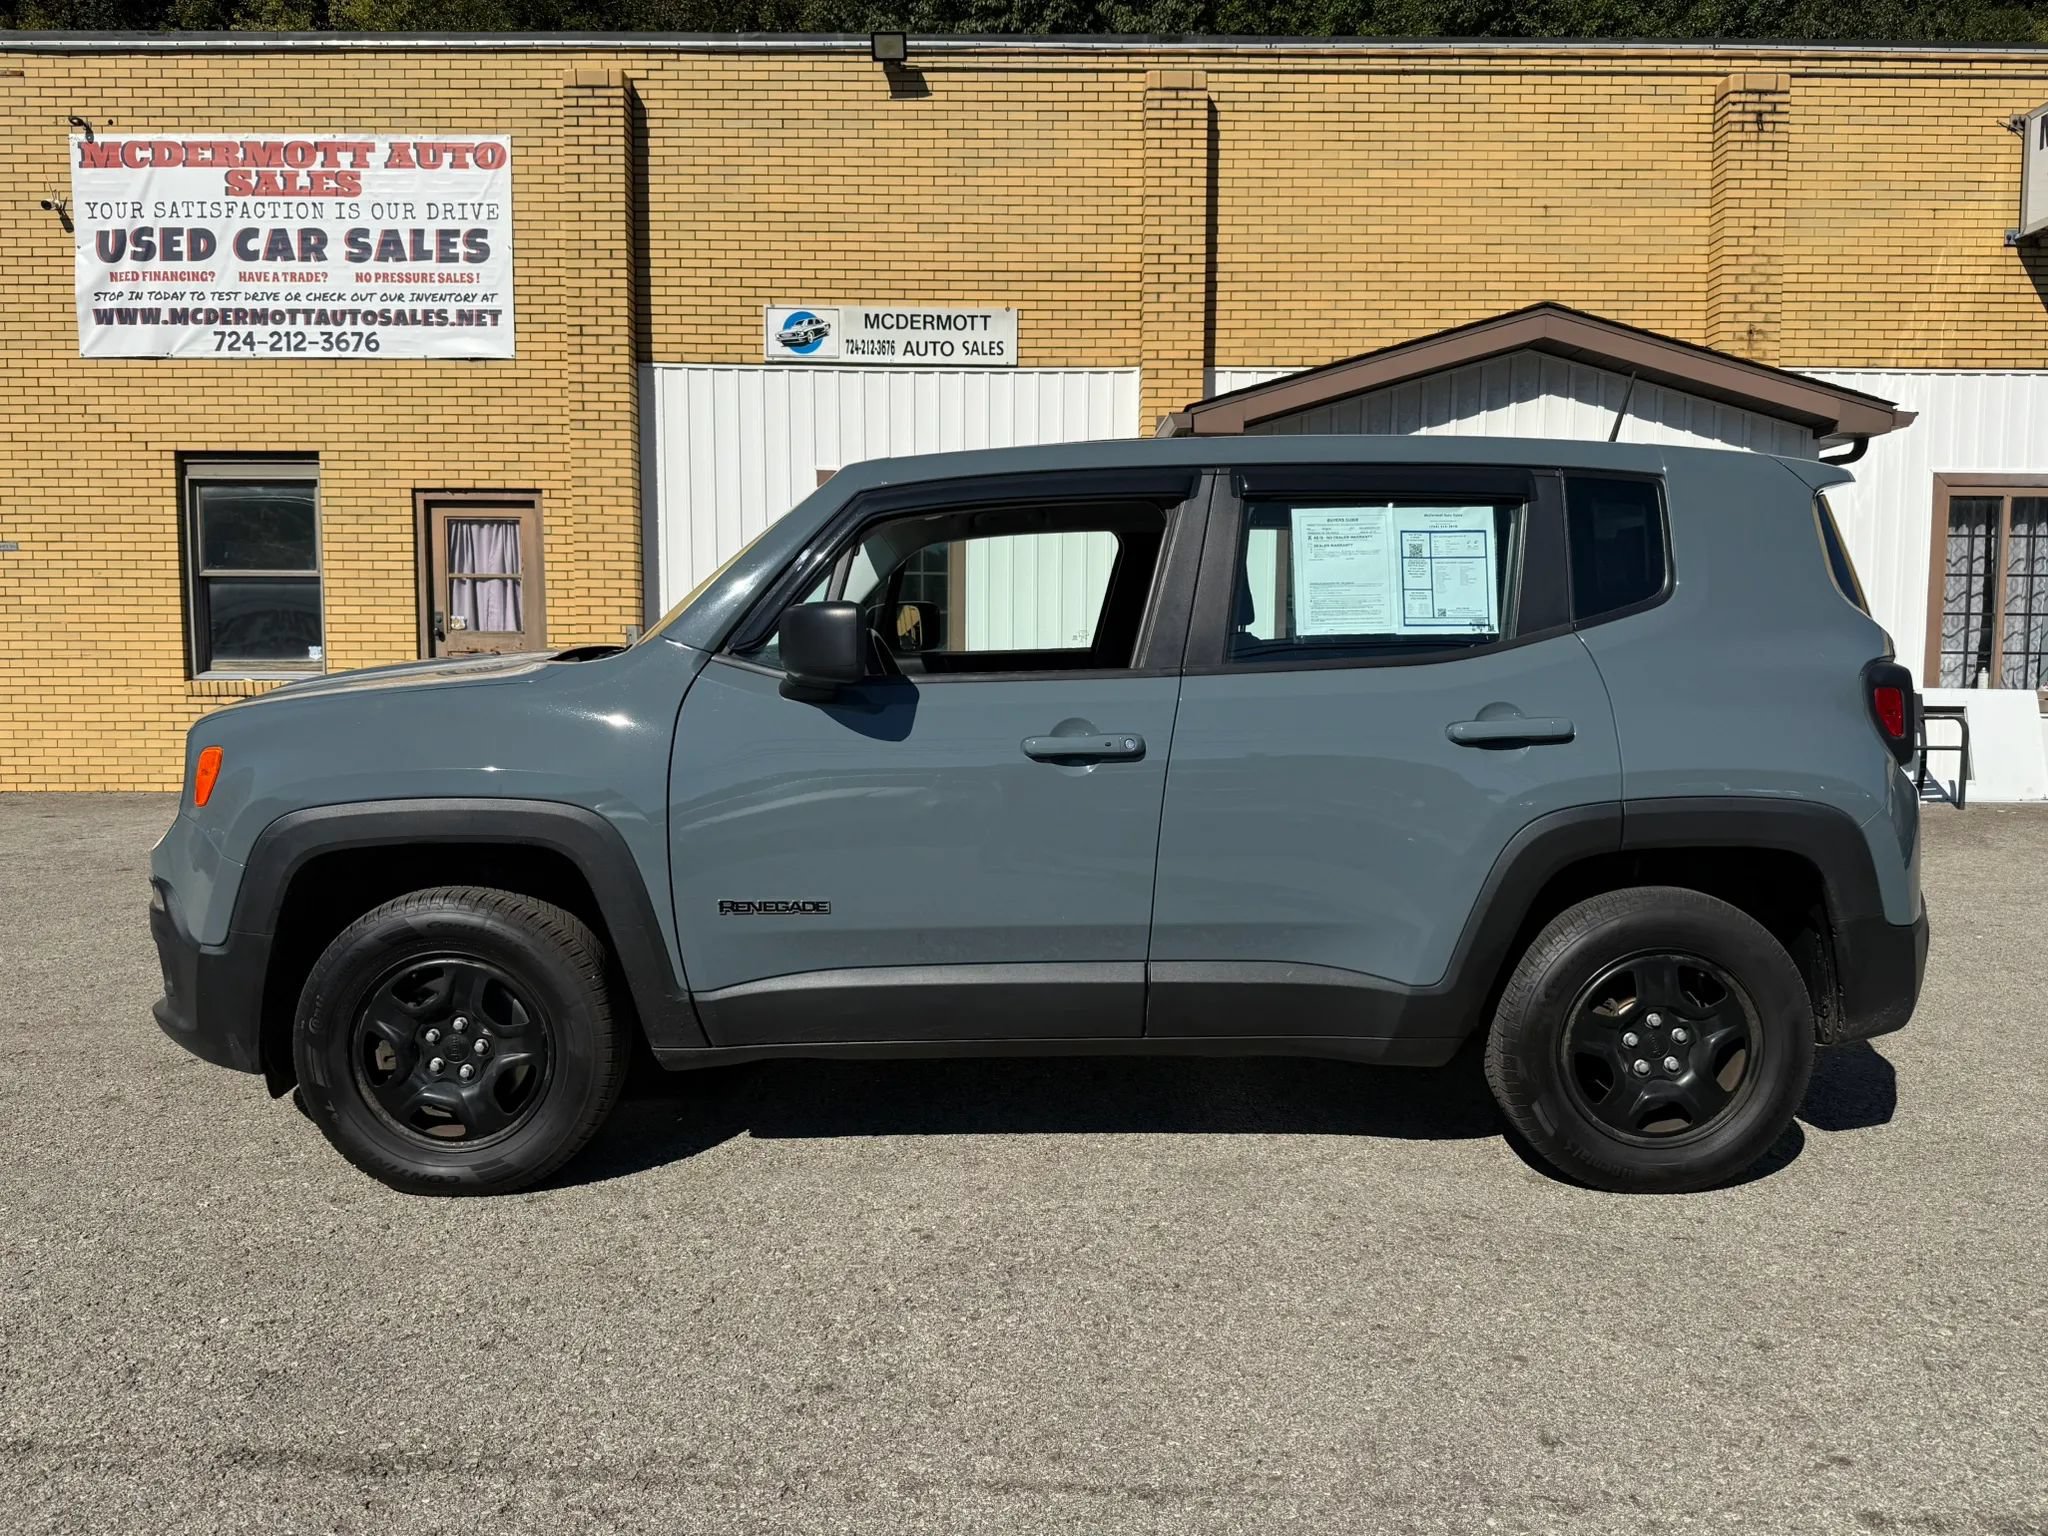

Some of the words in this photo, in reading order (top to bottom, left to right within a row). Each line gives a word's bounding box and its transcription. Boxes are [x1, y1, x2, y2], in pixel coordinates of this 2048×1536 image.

[78, 141, 375, 168] MCDERMOTT
[384, 142, 506, 169] AUTO
[225, 170, 362, 197] SALES
[86, 201, 144, 219] YOUR
[154, 201, 324, 219] SATISFACTION
[335, 202, 360, 219] IS
[371, 202, 416, 220] OUR
[427, 202, 499, 220] DRIVE
[95, 226, 217, 263] USED
[233, 227, 328, 263] CAR
[344, 227, 490, 263] SALES
[110, 271, 139, 283] NEED
[142, 271, 216, 283] FINANCING?
[239, 271, 271, 282] HAVE
[272, 272, 280, 282] A
[281, 272, 328, 283] TRADE?
[355, 272, 371, 283] NO
[375, 272, 435, 283] PRESSURE
[94, 291, 123, 301] STOP
[128, 291, 143, 301] IN
[148, 291, 186, 301] TODAY
[190, 291, 206, 301] TO
[210, 291, 241, 301] TEST
[245, 292, 280, 301] DRIVE
[285, 292, 301, 301] OR
[306, 292, 346, 302] CHECK
[351, 292, 376, 302] OUT
[380, 292, 405, 302] OUR
[409, 292, 477, 302] INVENTORY
[481, 293, 498, 302] AT
[93, 307, 502, 326] WWW.MCDERMOTTAUTOSALES.NET
[864, 313, 991, 331] MCDERMOTT
[213, 331, 380, 352] 724-212-3676
[845, 339, 895, 356] 724-212-3676
[902, 340, 954, 357] AUTO
[962, 340, 1004, 356] SALES
[718, 899, 831, 915] RENEGADE
